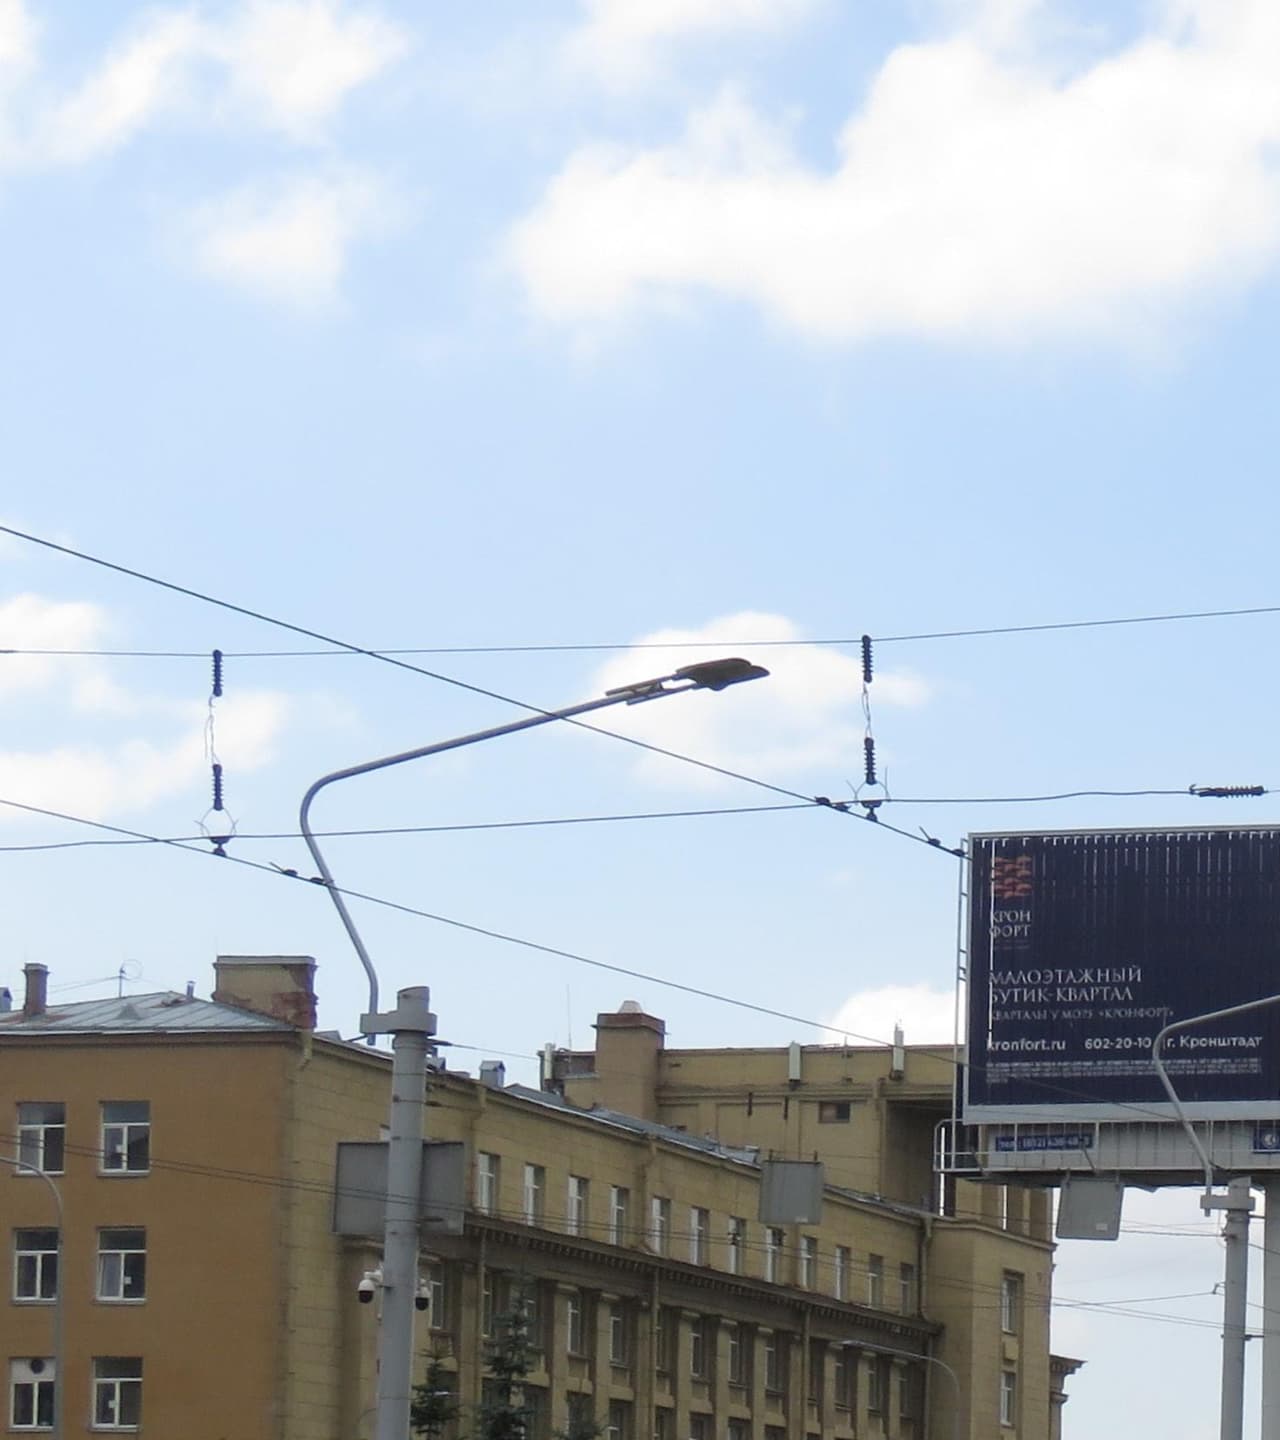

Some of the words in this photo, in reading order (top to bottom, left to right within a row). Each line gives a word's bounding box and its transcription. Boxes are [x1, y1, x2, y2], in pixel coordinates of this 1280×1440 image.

[989, 924, 1031, 938] ФОРТ
[989, 965, 1142, 985] МАЛОЭТАЖНЫЙ
[986, 1037, 1066, 1051] kronfort.ru
[1084, 1037, 1152, 1050] 602-20-10
[1167, 1038, 1176, 1048] г.
[1180, 1035, 1263, 1050] Кронштадт
